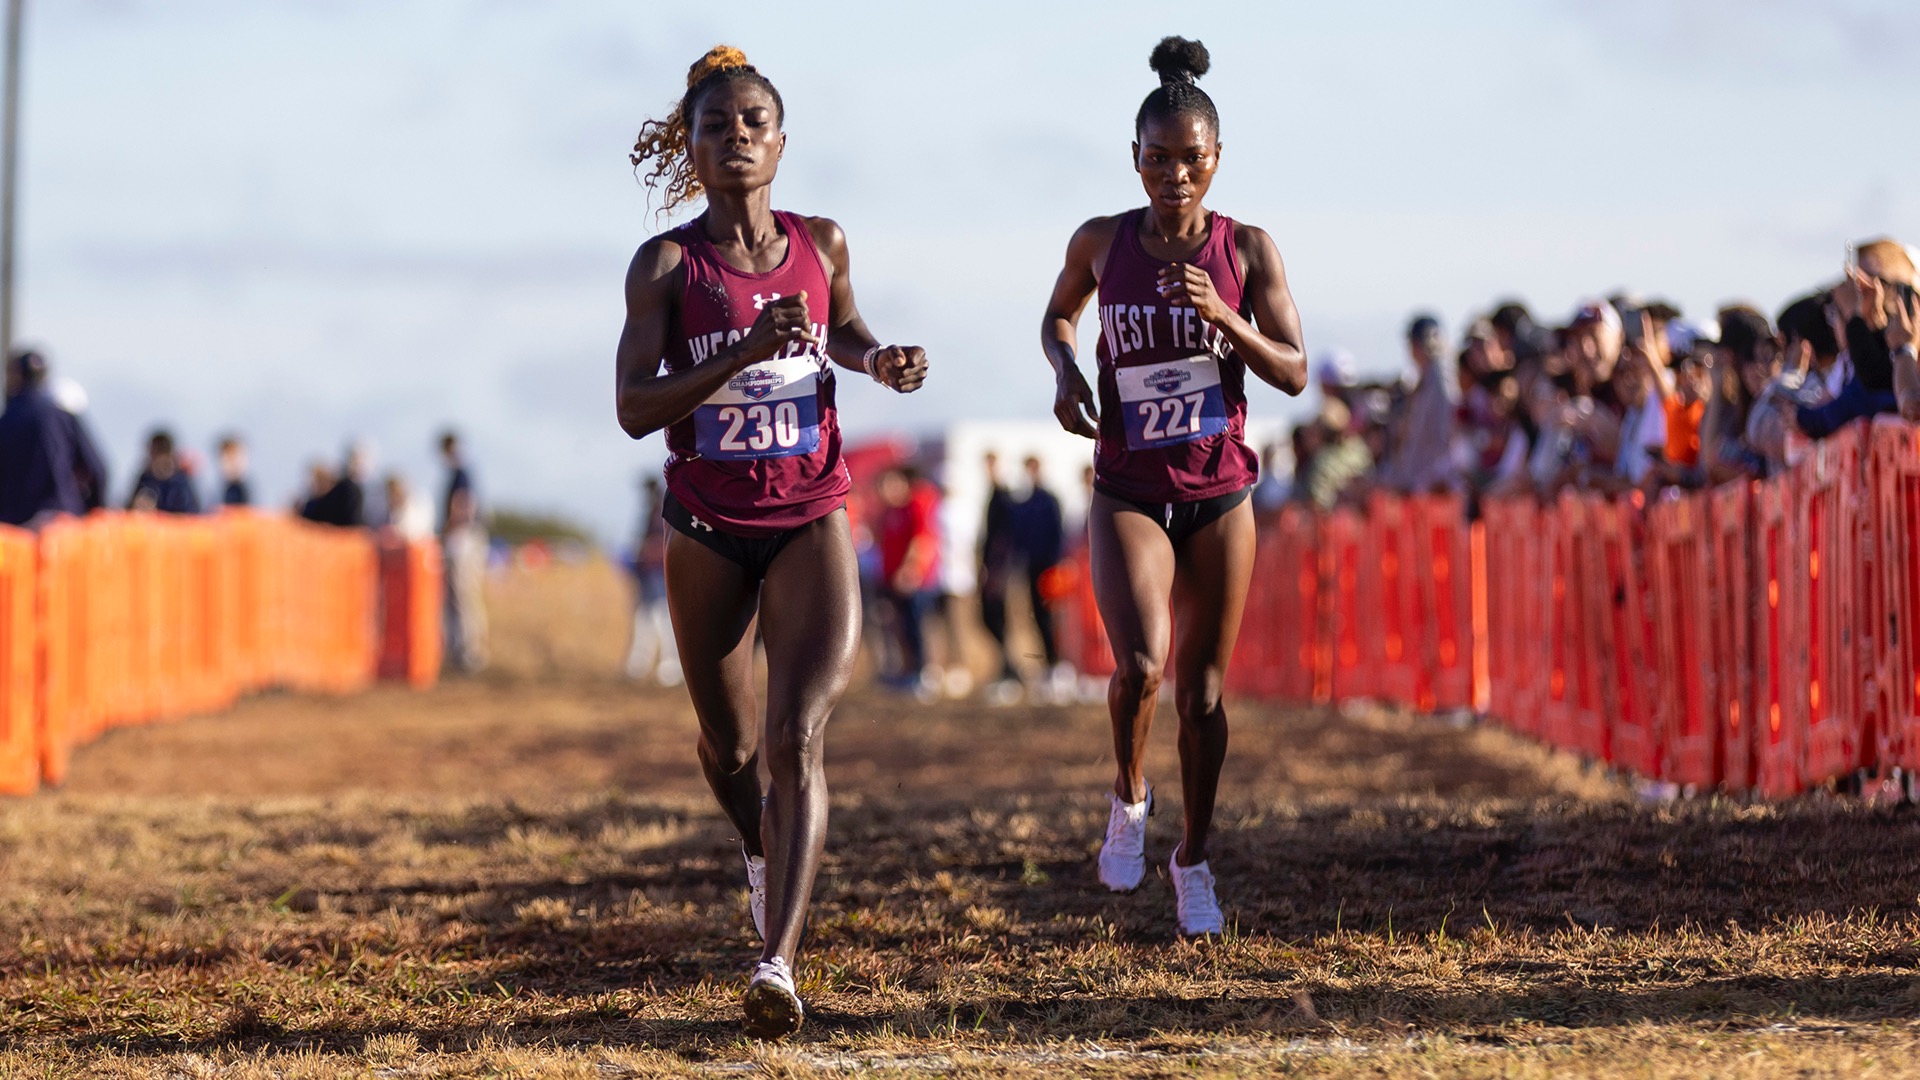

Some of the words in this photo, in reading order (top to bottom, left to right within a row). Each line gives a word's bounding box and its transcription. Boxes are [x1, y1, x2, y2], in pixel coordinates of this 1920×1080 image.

[1101, 304, 1156, 359] WEST
[718, 402, 799, 450] 230
[1139, 391, 1205, 440] 227
